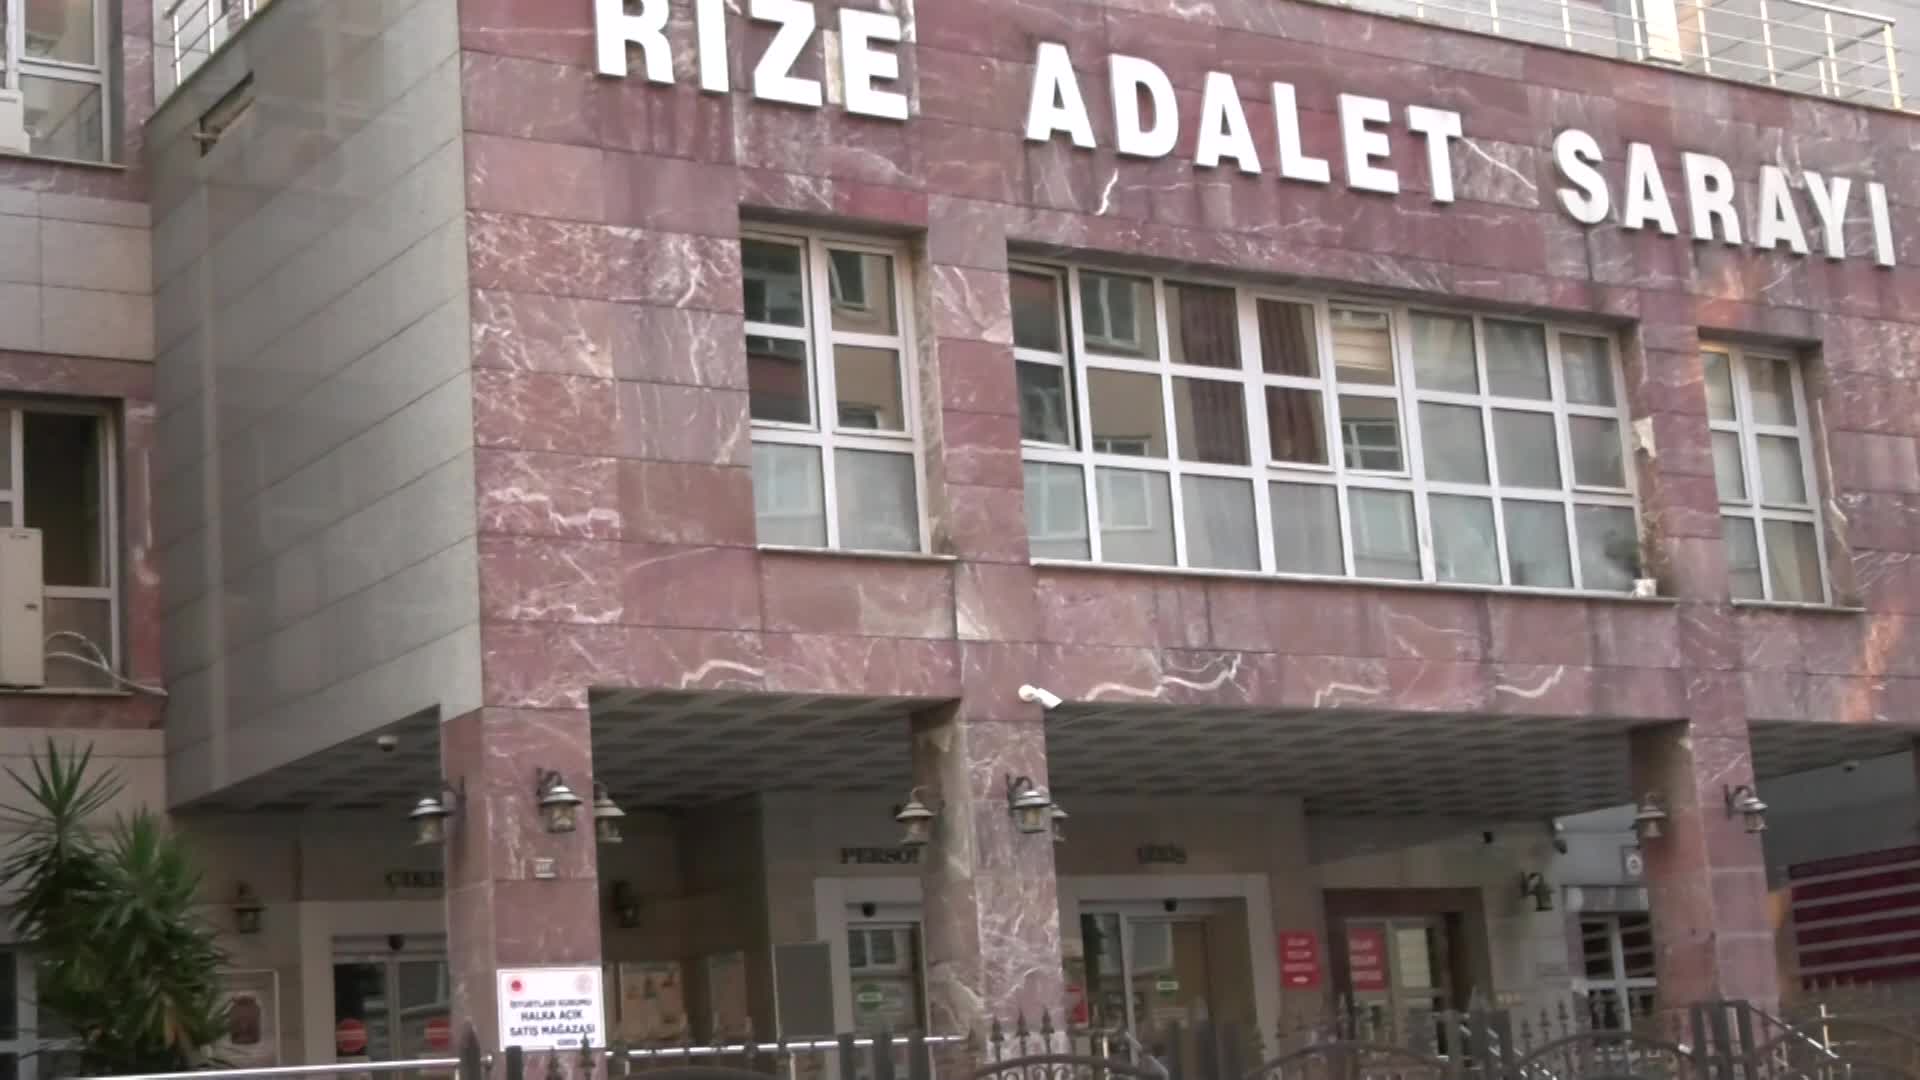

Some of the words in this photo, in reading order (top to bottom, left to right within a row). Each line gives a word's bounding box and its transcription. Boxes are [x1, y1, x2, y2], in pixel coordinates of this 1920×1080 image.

[594, 0, 909, 120] RIZE
[1025, 41, 1463, 203] ADALET
[1552, 128, 1896, 268] SARAYI
[839, 848, 919, 865] PERSO
[521, 1011, 556, 1020] HALKA
[559, 1009, 582, 1020] AÇIK
[510, 1026, 539, 1036] SATIŞ
[541, 1023, 595, 1034] MAĞAZASI
